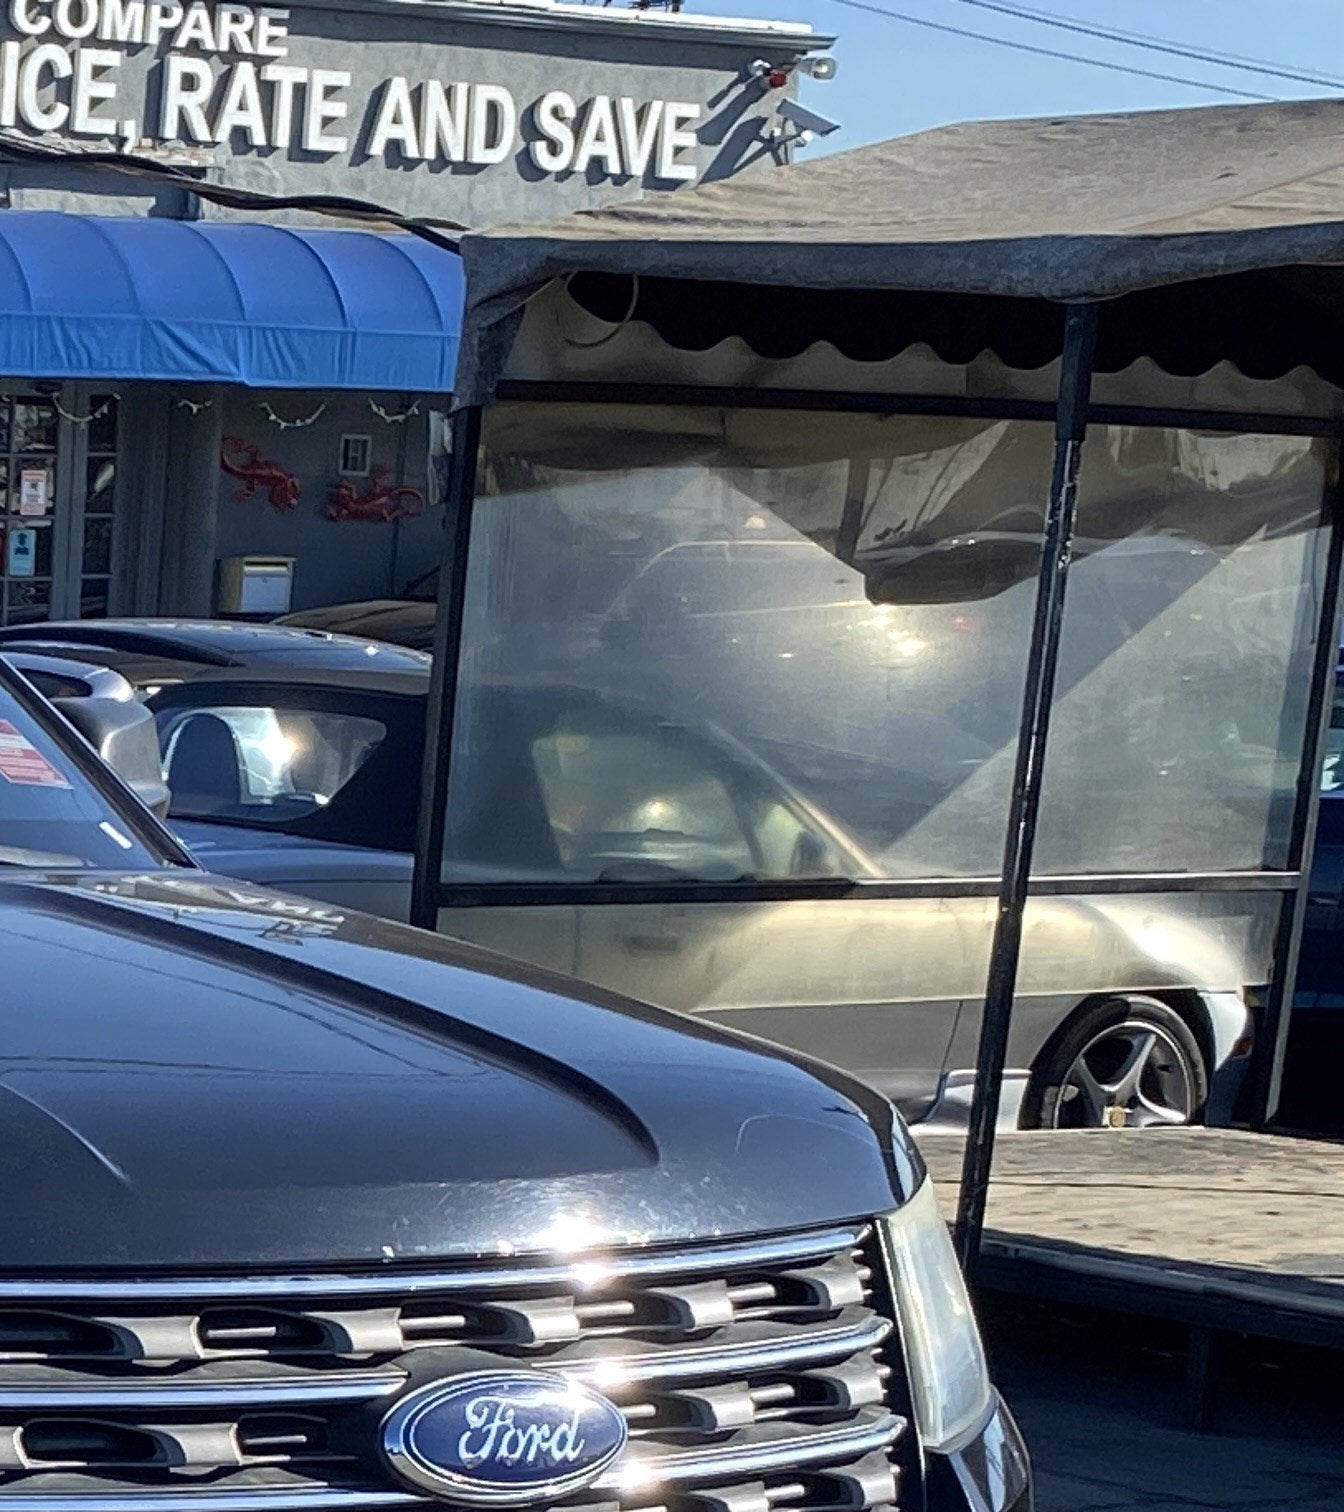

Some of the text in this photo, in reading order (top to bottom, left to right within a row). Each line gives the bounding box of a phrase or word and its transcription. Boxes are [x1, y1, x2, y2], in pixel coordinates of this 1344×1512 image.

[11, 0, 291, 57] COMPARE
[160, 51, 351, 154] RATE
[368, 76, 512, 164] AND
[530, 89, 702, 180] SAVE
[458, 1396, 585, 1462] Ford
